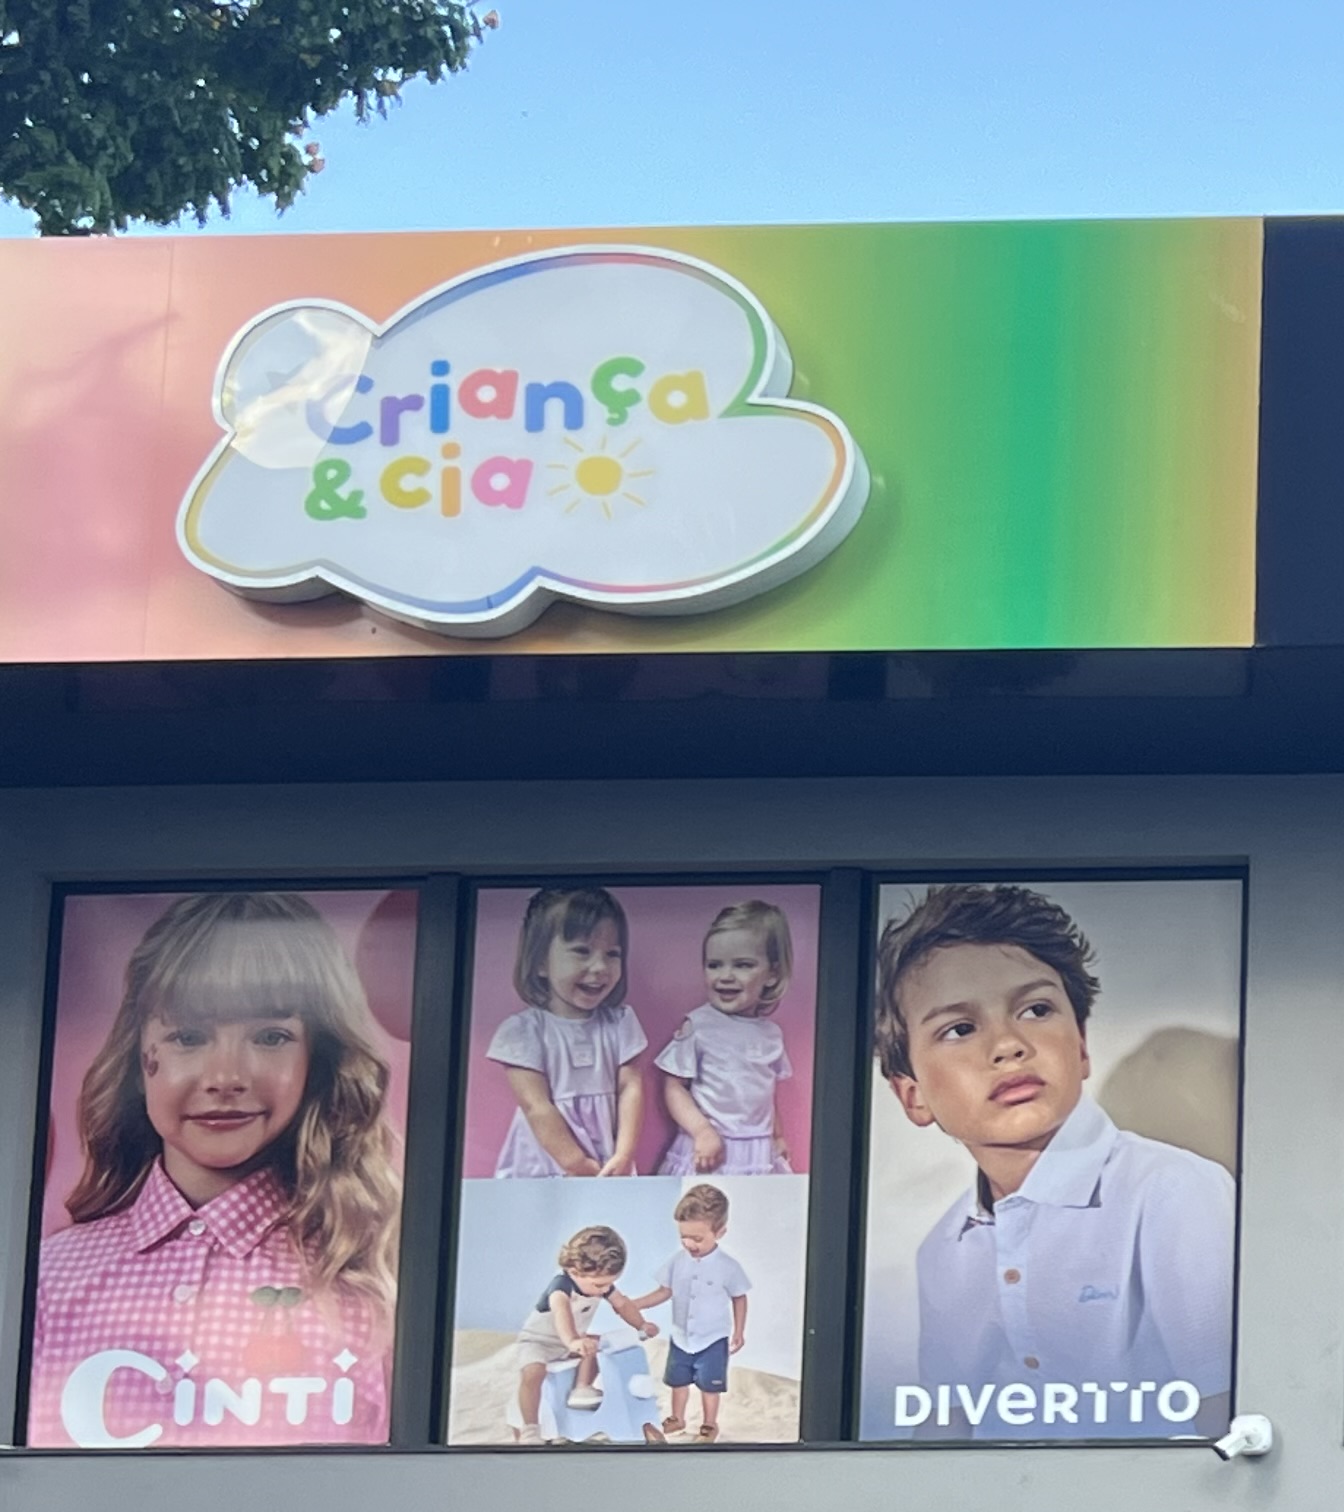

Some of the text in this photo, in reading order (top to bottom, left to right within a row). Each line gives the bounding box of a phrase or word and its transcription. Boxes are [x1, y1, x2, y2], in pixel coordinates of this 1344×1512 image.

[306, 356, 710, 446] Criança
[304, 442, 534, 521] & cia
